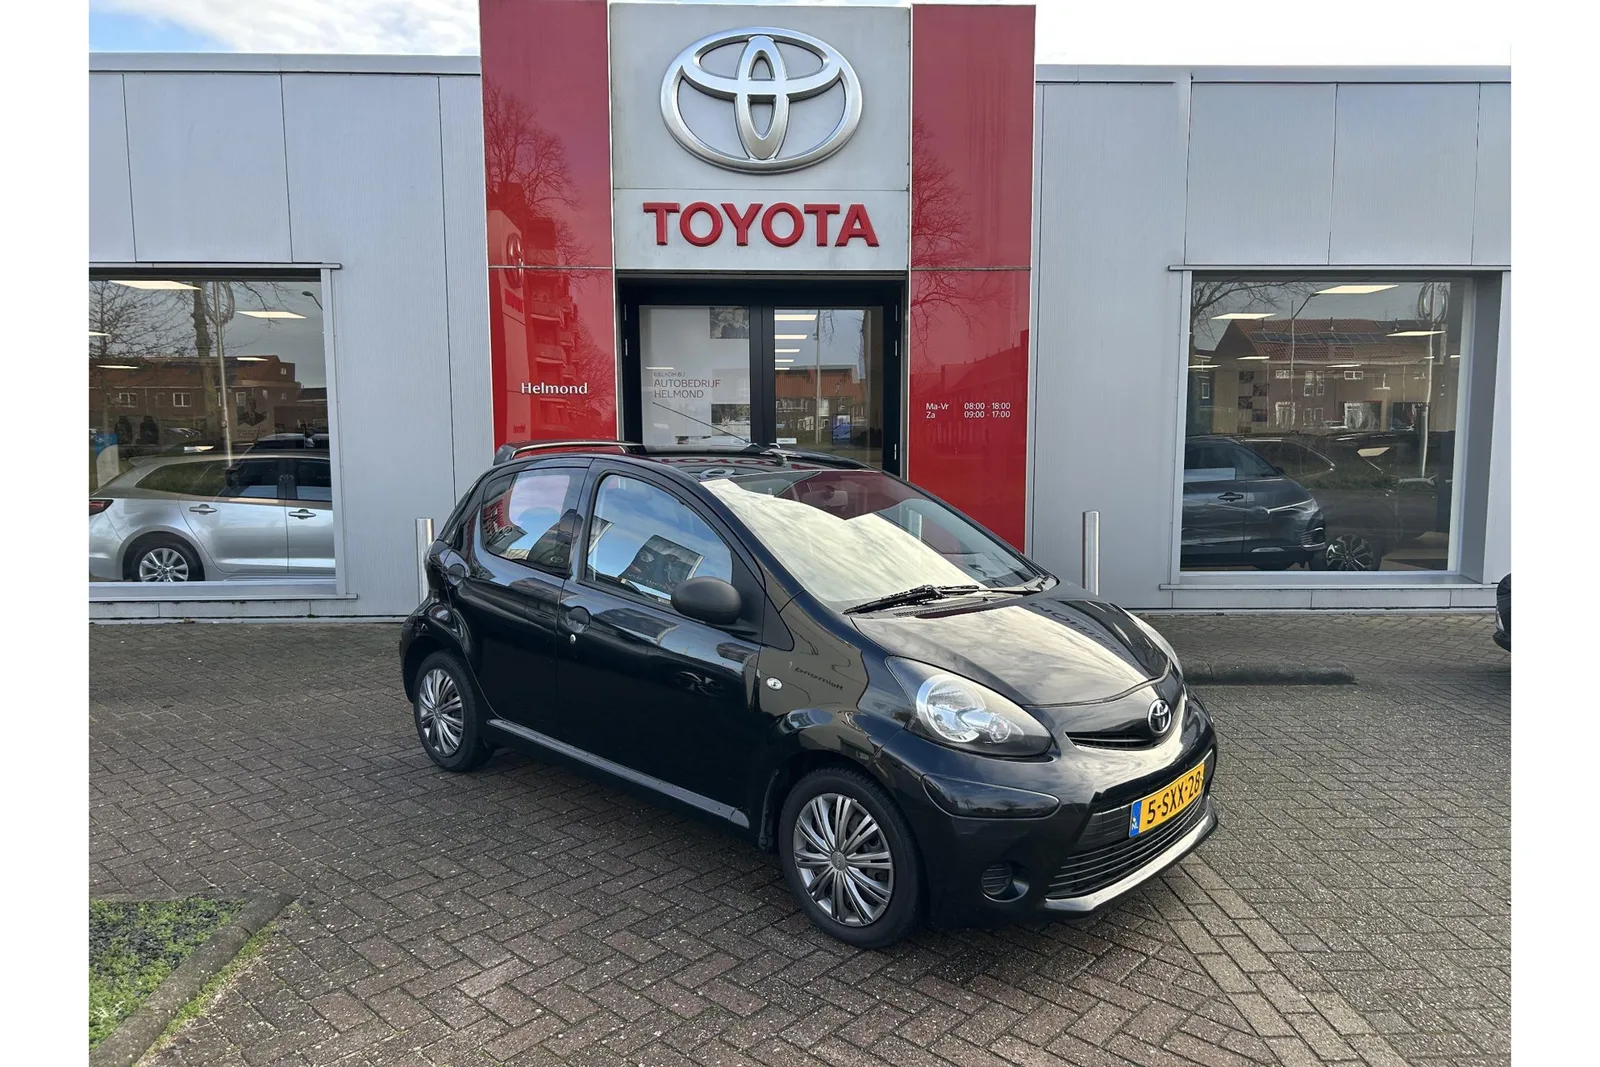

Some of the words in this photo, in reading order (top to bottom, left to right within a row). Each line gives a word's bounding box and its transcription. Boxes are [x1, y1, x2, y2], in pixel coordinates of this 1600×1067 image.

[642, 201, 880, 248] TOYOTA
[521, 382, 588, 394] Helmond
[654, 379, 720, 388] AUTOBEDRIJF
[654, 390, 704, 398] HELMOND
[1147, 770, 1201, 824] 5-SXX-28
[1132, 822, 1138, 830] NL
